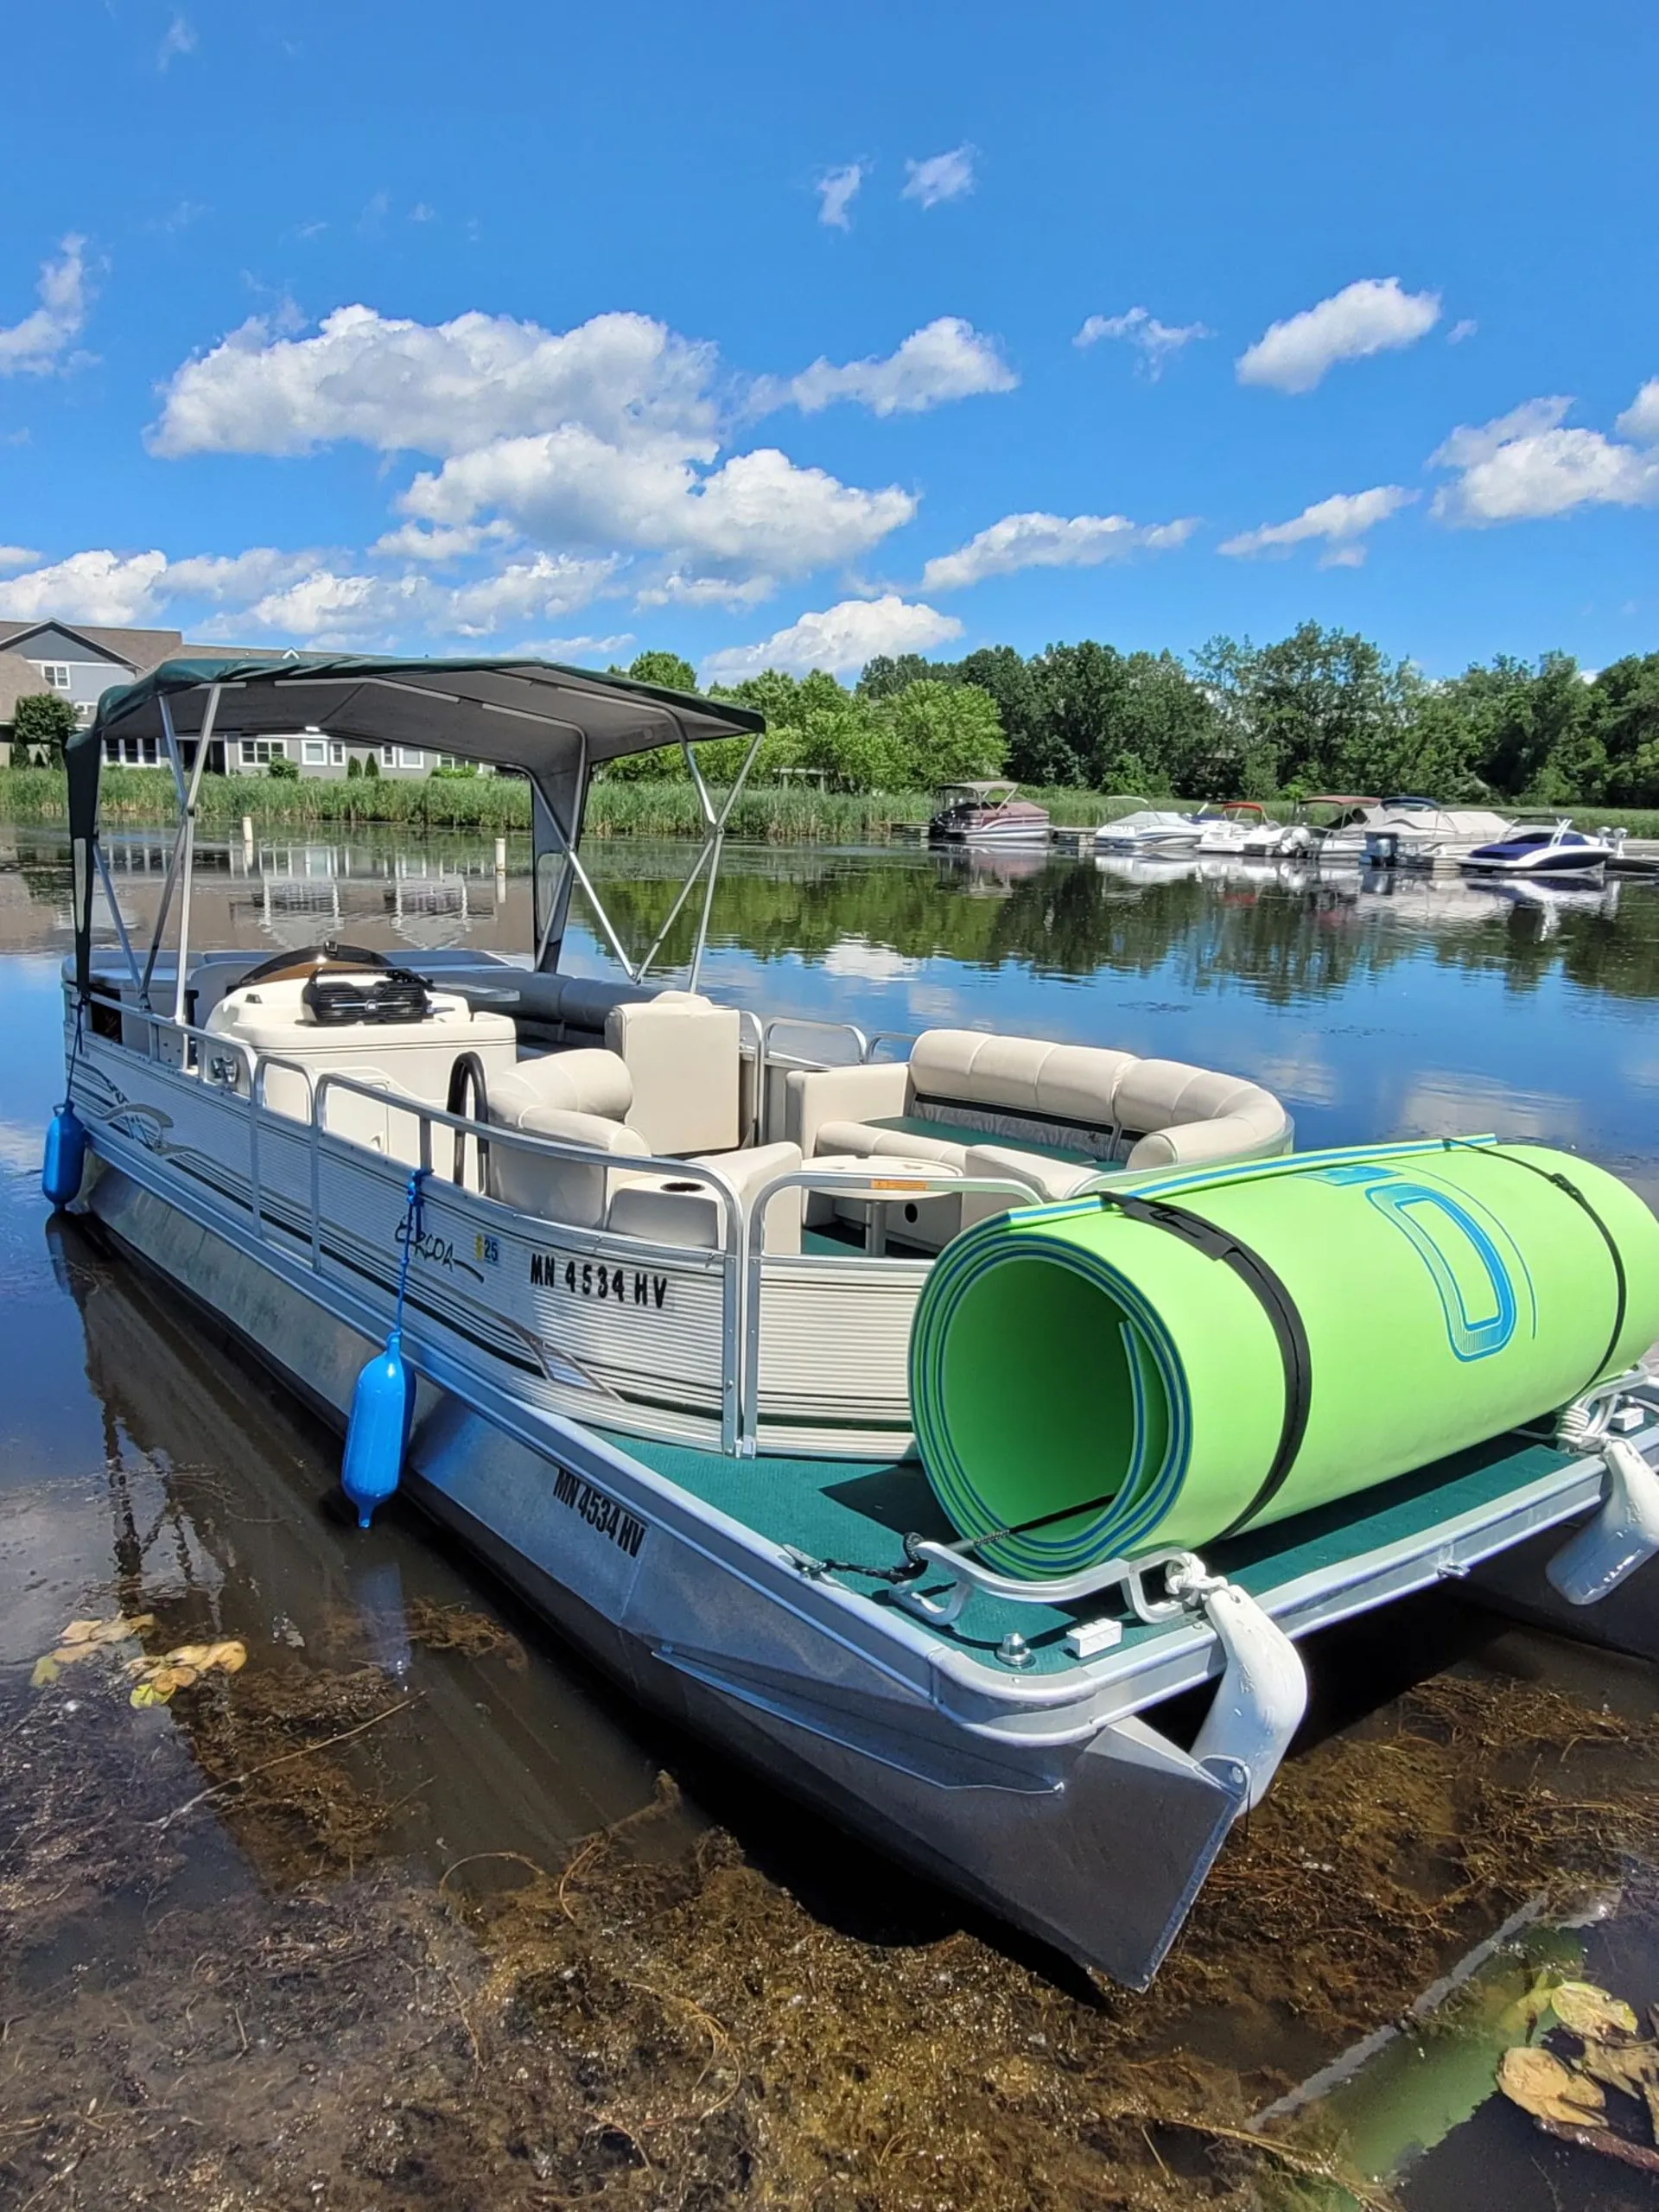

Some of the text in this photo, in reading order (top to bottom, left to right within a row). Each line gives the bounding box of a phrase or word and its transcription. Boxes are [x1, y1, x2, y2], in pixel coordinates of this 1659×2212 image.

[484, 1238, 499, 1262] 25
[531, 1254, 667, 1309] MN 4534 HV
[553, 1469, 645, 1558] MN 4534 HV
